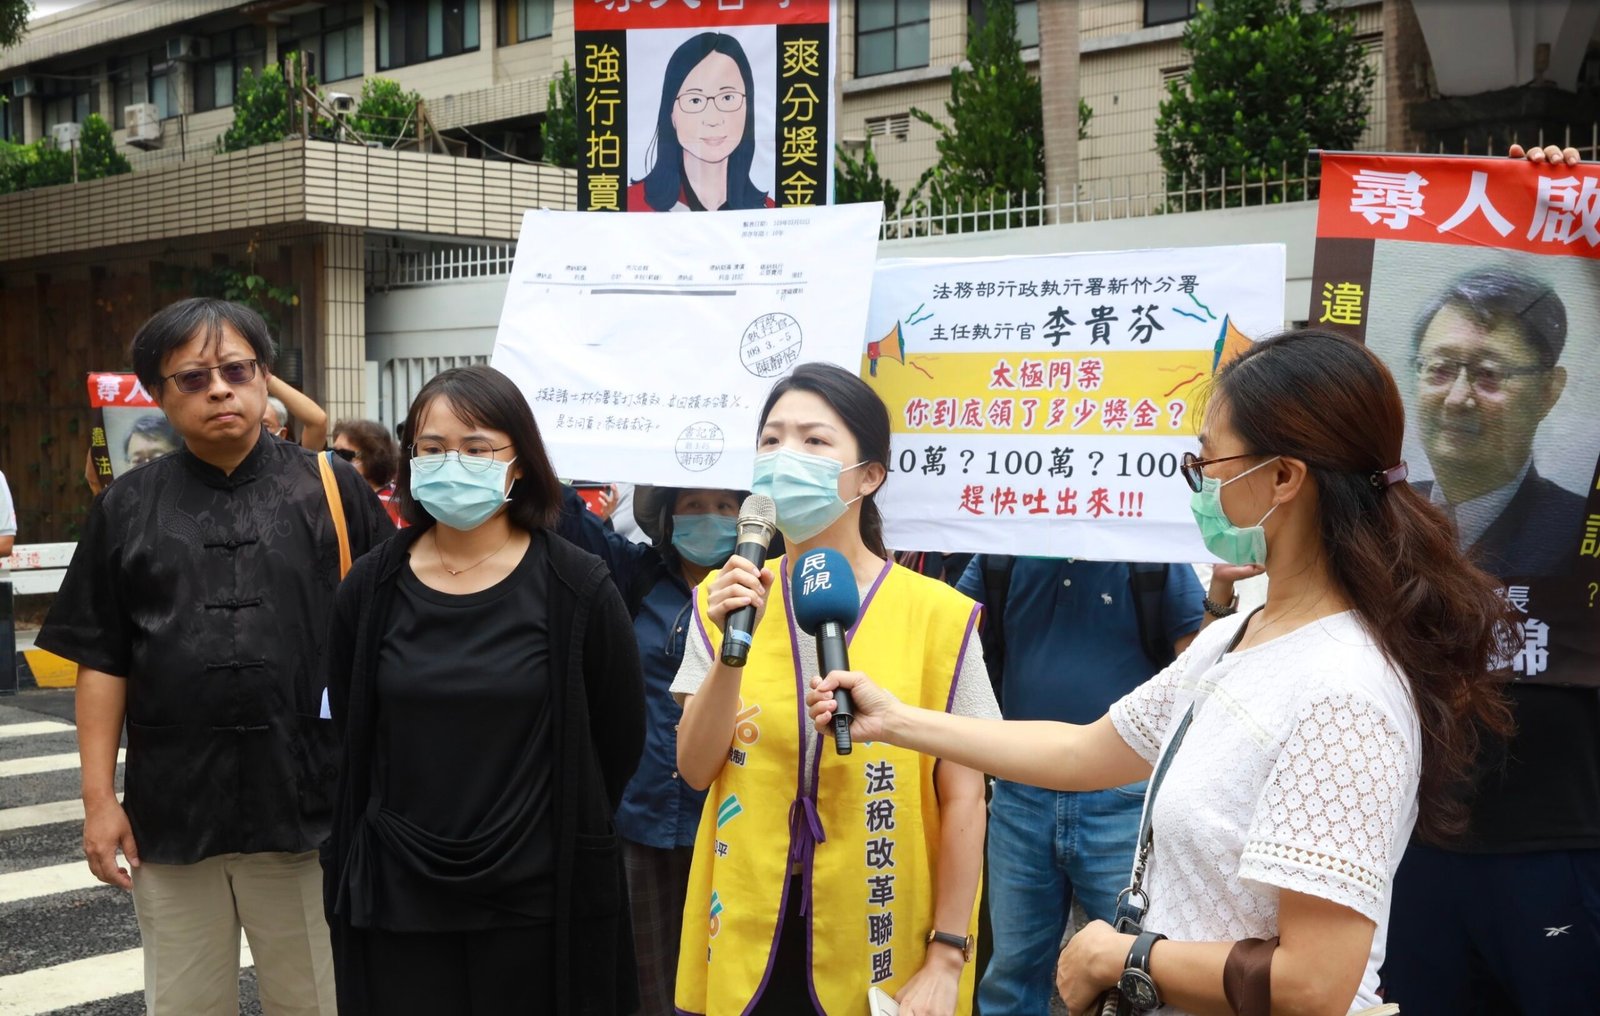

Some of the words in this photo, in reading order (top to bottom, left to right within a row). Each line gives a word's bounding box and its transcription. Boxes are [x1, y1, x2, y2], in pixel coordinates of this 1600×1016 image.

[585, 43, 621, 211] 強行拍賣
[781, 38, 819, 208] 爽分獎金
[1350, 169, 1600, 248] 尋人啟
[932, 275, 1200, 299] 法務部行政執行署新竹分署
[929, 322, 1036, 342] 主任執行官
[1042, 305, 1165, 347] 李貴芬
[990, 360, 1103, 390] 太極門案
[905, 399, 1185, 429] 你到底領了多少獎金？
[958, 485, 1144, 518] 趕快吐出來!!!
[801, 553, 831, 596] 民視
